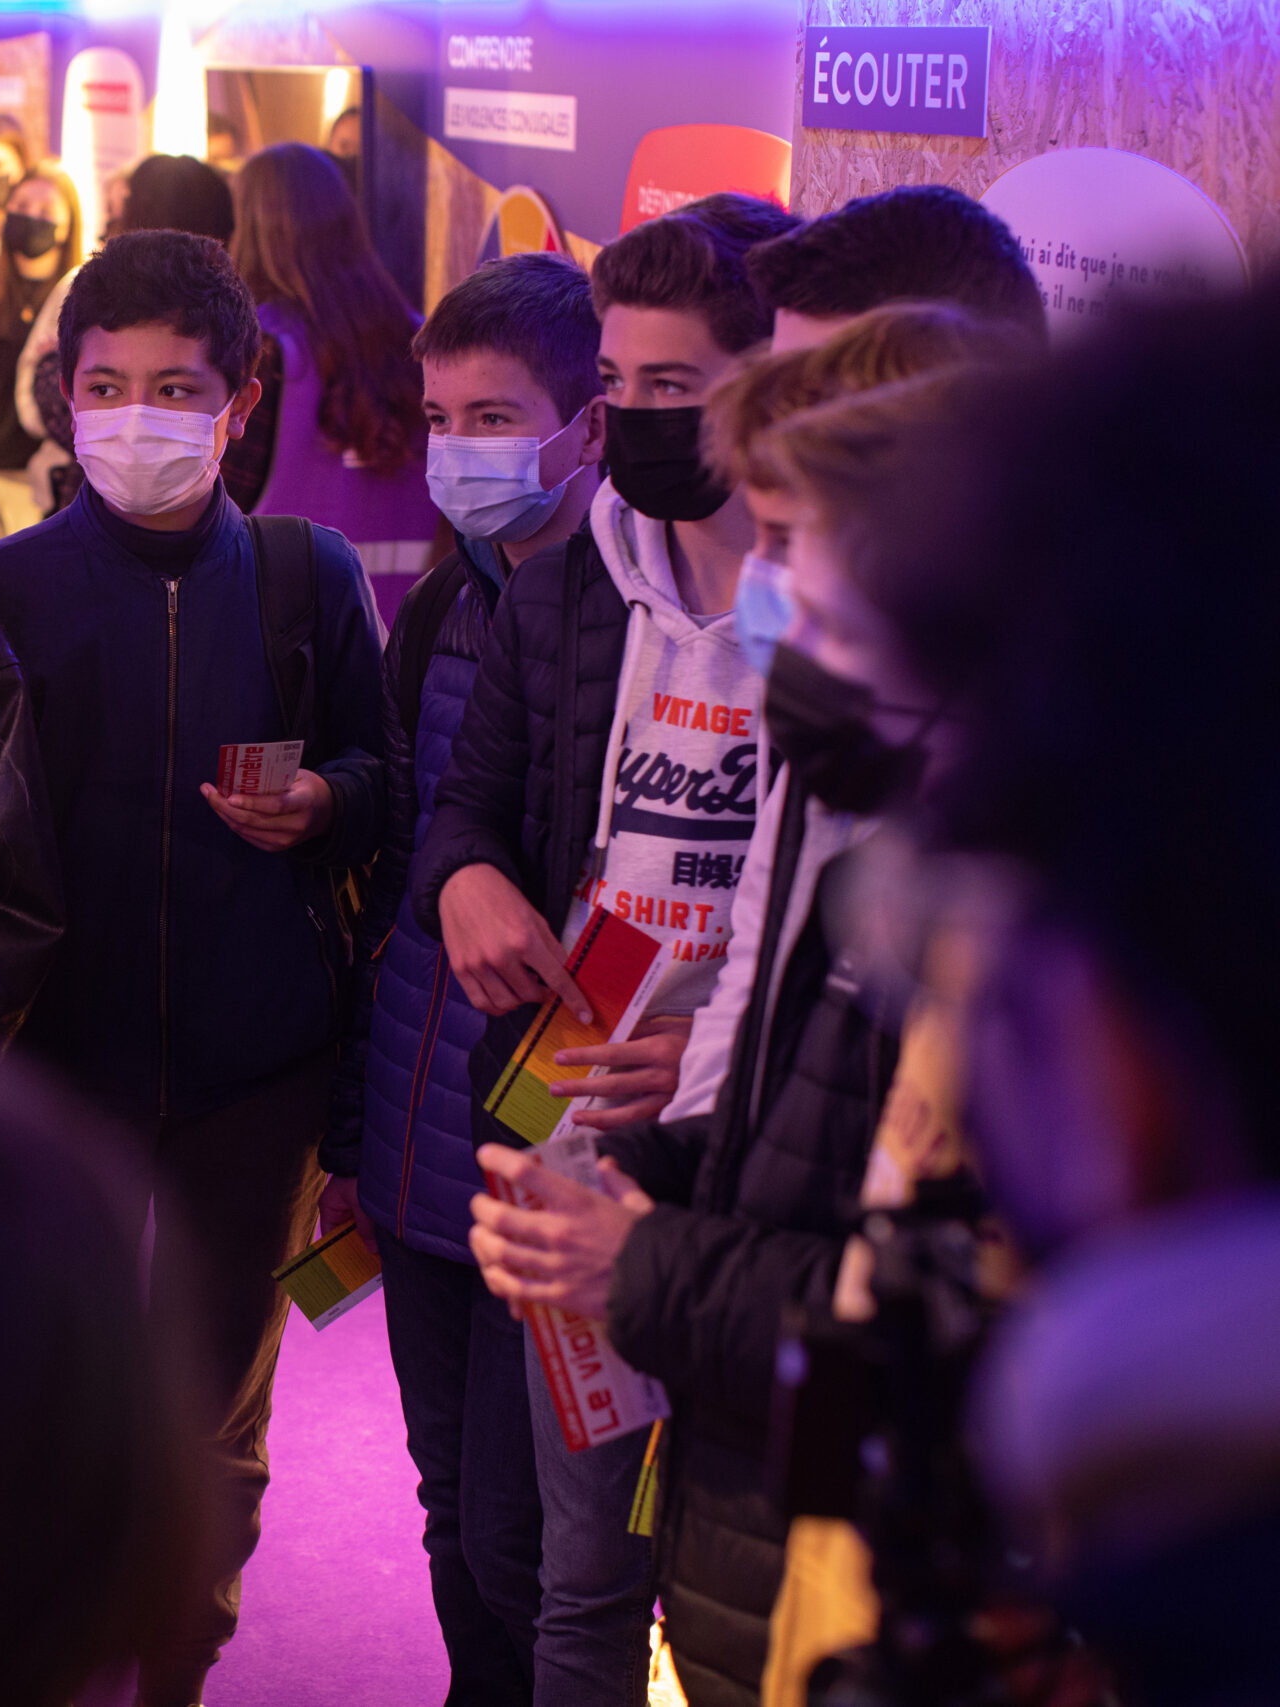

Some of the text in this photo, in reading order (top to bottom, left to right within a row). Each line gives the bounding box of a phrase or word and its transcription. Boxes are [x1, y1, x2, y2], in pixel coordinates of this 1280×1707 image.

[814, 35, 968, 110] ÉCOUTER
[1038, 241, 1051, 265] ai
[1055, 242, 1076, 270] dit
[1080, 254, 1107, 282] que
[1108, 252, 1124, 288] je
[1129, 265, 1148, 284] ne
[1053, 284, 1064, 310] il
[1067, 294, 1085, 315] ne
[238, 746, 264, 795] ntomètre
[614, 889, 723, 934] SHIRT.
